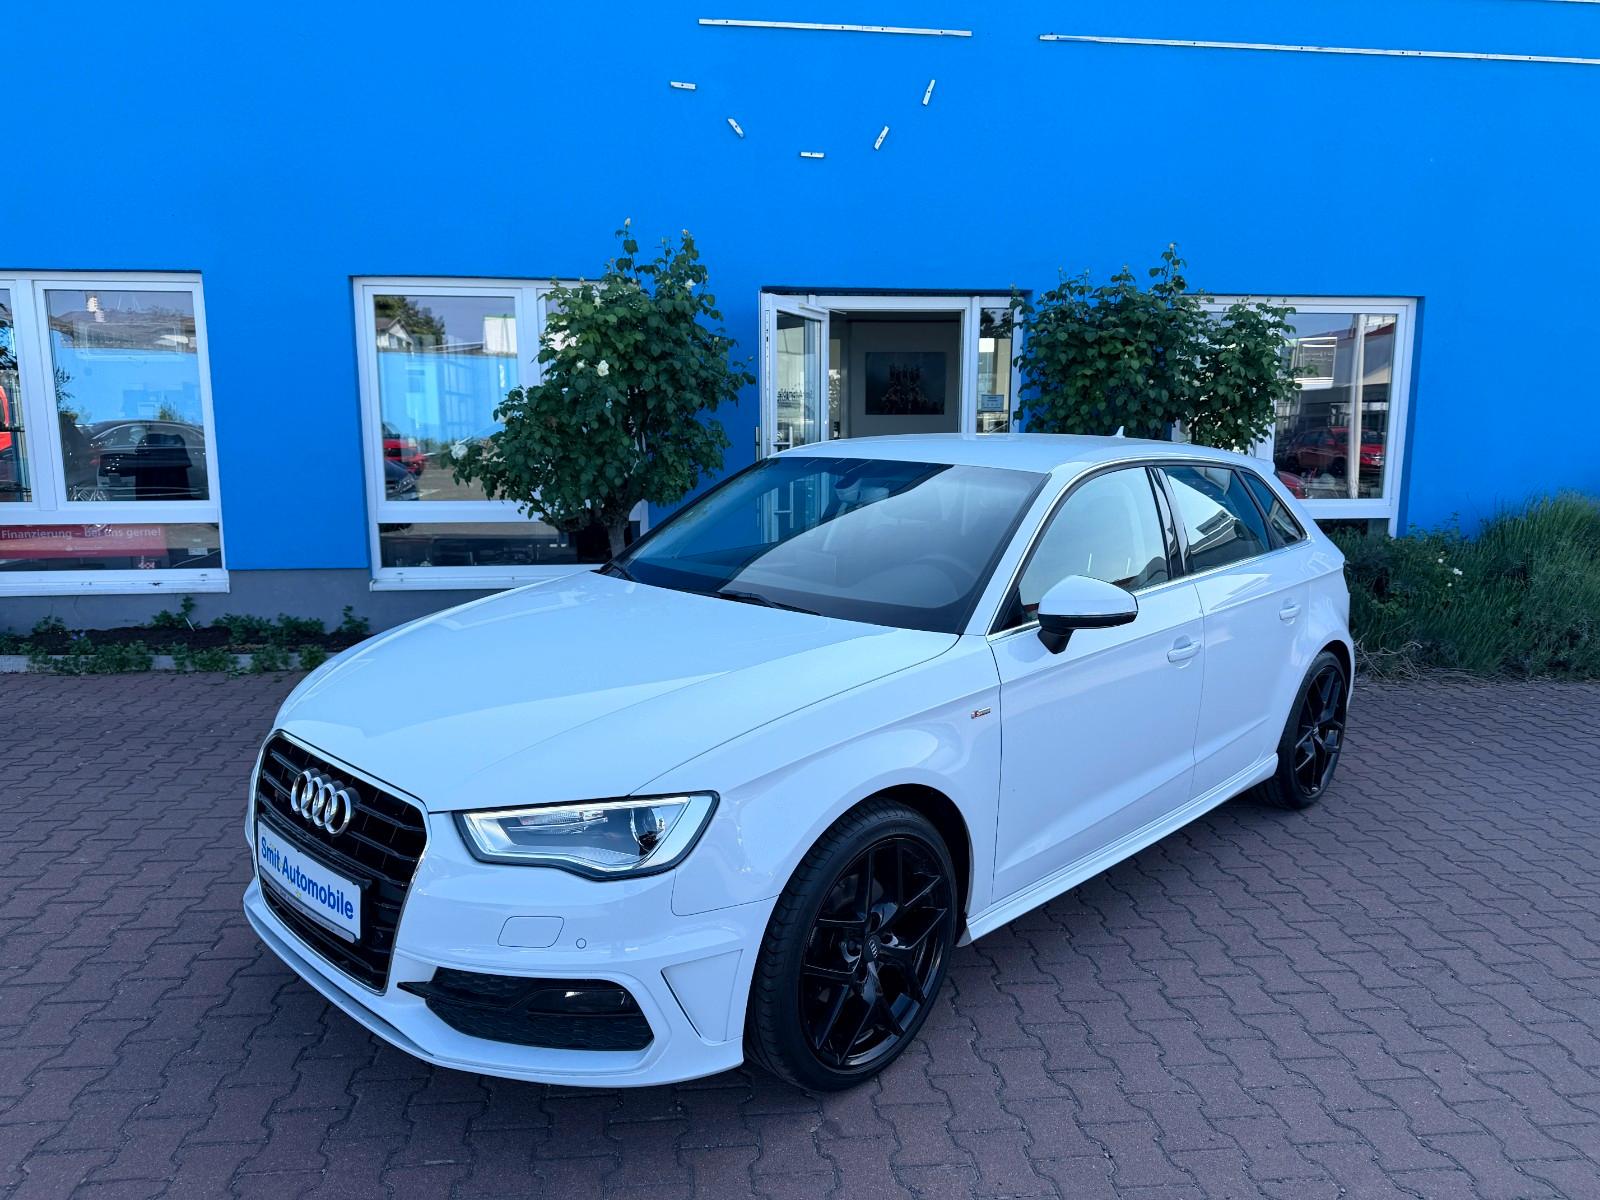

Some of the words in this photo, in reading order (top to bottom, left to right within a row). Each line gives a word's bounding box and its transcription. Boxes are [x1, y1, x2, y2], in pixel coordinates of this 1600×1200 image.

[1, 530, 72, 540] Finanzierung
[127, 527, 161, 538] gerne!
[261, 836, 281, 872] Smit
[282, 857, 353, 920] Automobile
